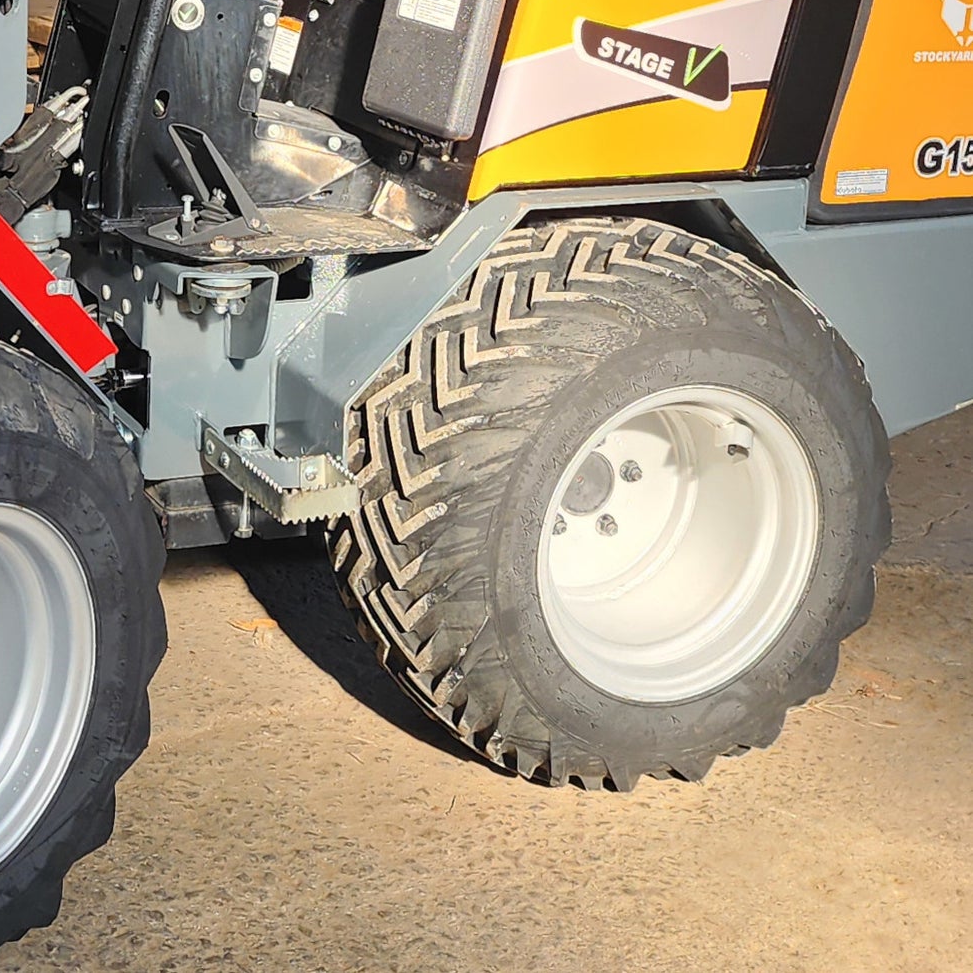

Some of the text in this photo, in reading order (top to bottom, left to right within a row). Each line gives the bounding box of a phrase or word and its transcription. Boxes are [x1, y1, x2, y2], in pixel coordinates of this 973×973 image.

[597, 36, 724, 87] STAGE V
[913, 50, 973, 63] STOCKYAR
